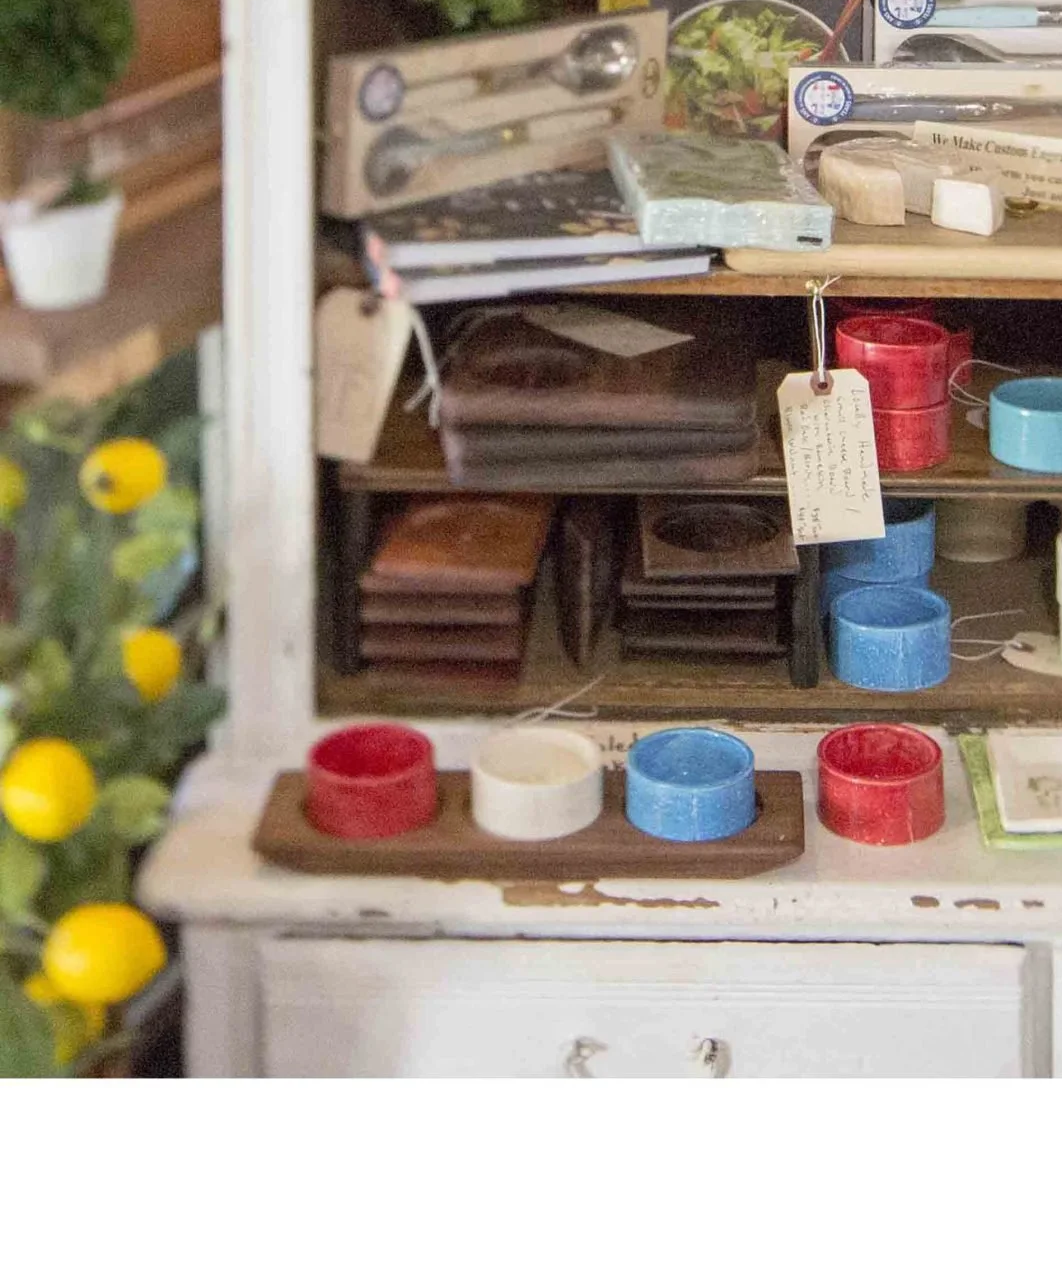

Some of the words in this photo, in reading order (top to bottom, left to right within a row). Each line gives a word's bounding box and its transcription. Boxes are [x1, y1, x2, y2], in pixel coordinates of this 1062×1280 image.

[932, 132, 949, 145] We
[953, 135, 983, 153] Make
[985, 140, 1029, 158] Custom
[859, 440, 876, 503] Handmade
